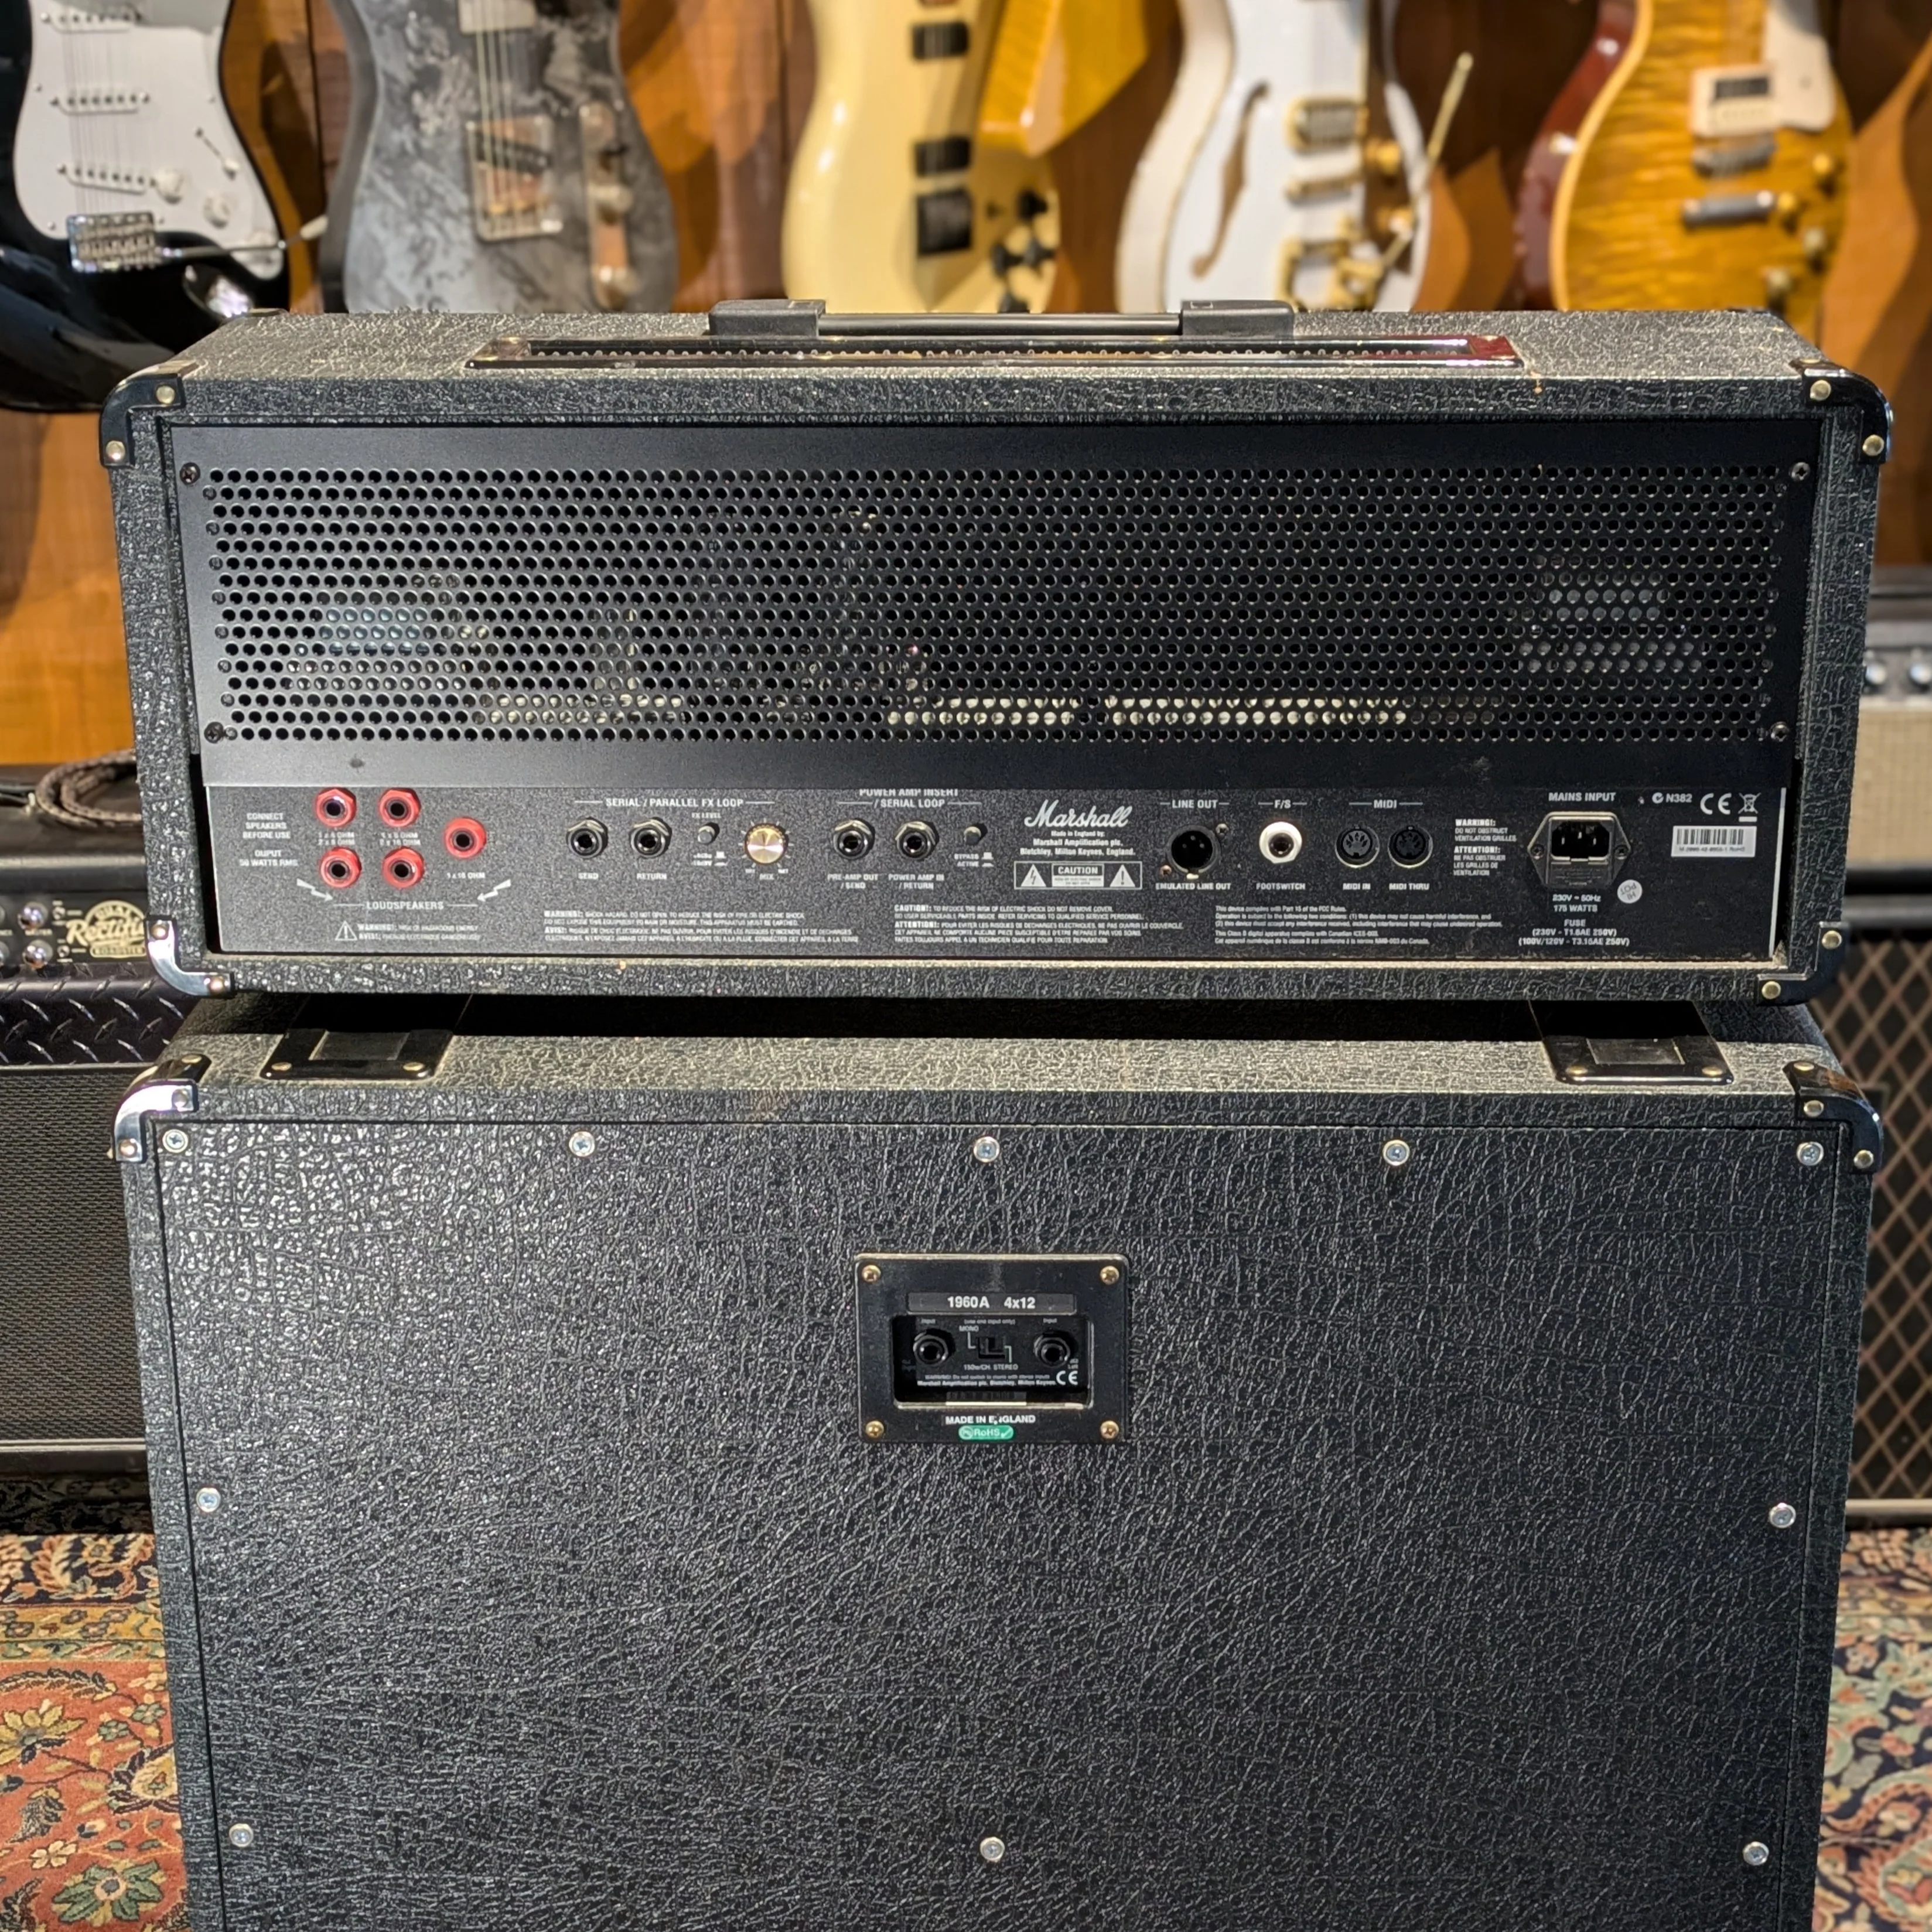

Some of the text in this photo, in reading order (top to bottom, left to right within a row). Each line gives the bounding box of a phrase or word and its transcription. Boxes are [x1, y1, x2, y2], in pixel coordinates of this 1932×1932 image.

[1549, 792, 1616, 802] MAINS INPUT
[1665, 794, 1692, 803] N382
[605, 798, 641, 807] SERIAL
[650, 798, 698, 807] PARALLEL
[702, 798, 714, 807] FX
[716, 798, 744, 807] LOOP
[880, 799, 915, 808] SERIAL
[918, 799, 945, 808] LOOP
[1172, 800, 1218, 808] LINE OUT
[1275, 800, 1291, 808] F/S
[1374, 800, 1397, 808] MIDI
[1024, 799, 1132, 828] Marshall
[1054, 848, 1076, 856] Milton
[1552, 894, 1572, 902] 230V
[366, 901, 443, 909] LOUDSPEAKERS
[1518, 937, 1564, 946] (100V/120V
[1605, 937, 1630, 946] 250V)
[947, 1296, 1035, 1309] 1960A 4x12
[1056, 1370, 1078, 1385] CE
[945, 1415, 974, 1424] MADE
[976, 1415, 987, 1424] IN
